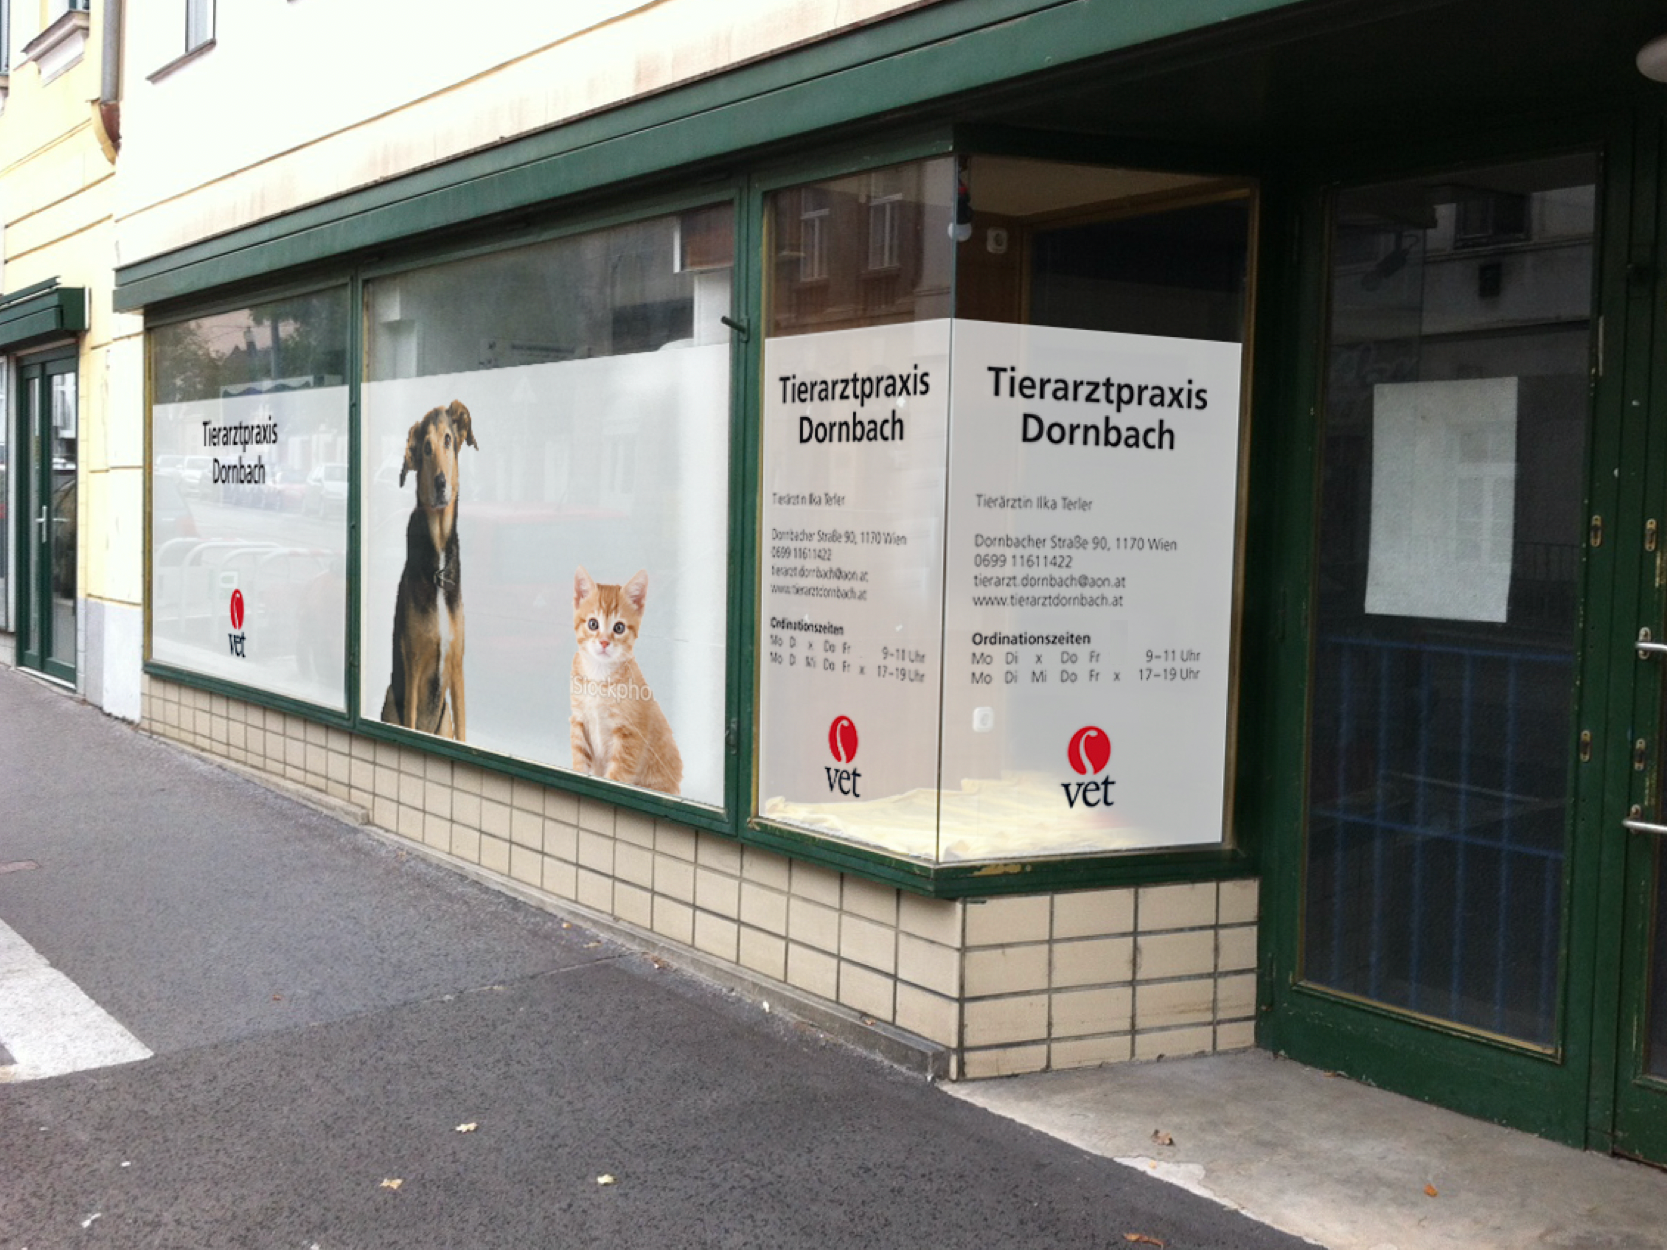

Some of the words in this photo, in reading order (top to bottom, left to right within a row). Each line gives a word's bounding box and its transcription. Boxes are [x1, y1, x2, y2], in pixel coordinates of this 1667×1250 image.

[779, 363, 930, 407] Tierarztpraxis
[987, 366, 1208, 412] Tierarztpraxis
[202, 415, 278, 452] Tierarztpraxis
[799, 409, 904, 443] Dornbach
[1021, 412, 1175, 450] Dornbach
[212, 455, 266, 484] Dornbach
[975, 494, 1033, 509] Tierärztin
[1036, 497, 1058, 510] Ilka
[1061, 496, 1093, 511] Terler
[974, 534, 1047, 549] Dornbacher
[1050, 535, 1089, 549] Straße
[1092, 537, 1111, 551] 90,
[1115, 537, 1145, 550] 1170
[1148, 538, 1178, 551] Wien
[974, 554, 1007, 568] 0699
[1011, 554, 1073, 568] 11611422
[974, 574, 1126, 588] tierarzt.dornbach@aon.at
[972, 594, 1124, 608] www.tierarztdornbach.at
[228, 632, 246, 658] vet
[971, 632, 1091, 646] Ordinationszeiten
[971, 653, 993, 665] Mo
[1005, 651, 1018, 664] Di
[1035, 654, 1043, 664] x
[1060, 651, 1078, 664] Do
[1089, 651, 1100, 663] Fr
[1180, 650, 1201, 662] Uhr
[971, 672, 992, 684] Mo
[1005, 671, 1018, 683] Di
[1031, 671, 1047, 683] Mi
[1060, 671, 1077, 683] Do
[1089, 670, 1100, 682] Fr
[1113, 671, 1121, 681] x
[1180, 668, 1200, 680] Uhr
[824, 766, 862, 798] vet
[1061, 775, 1116, 808] vet
